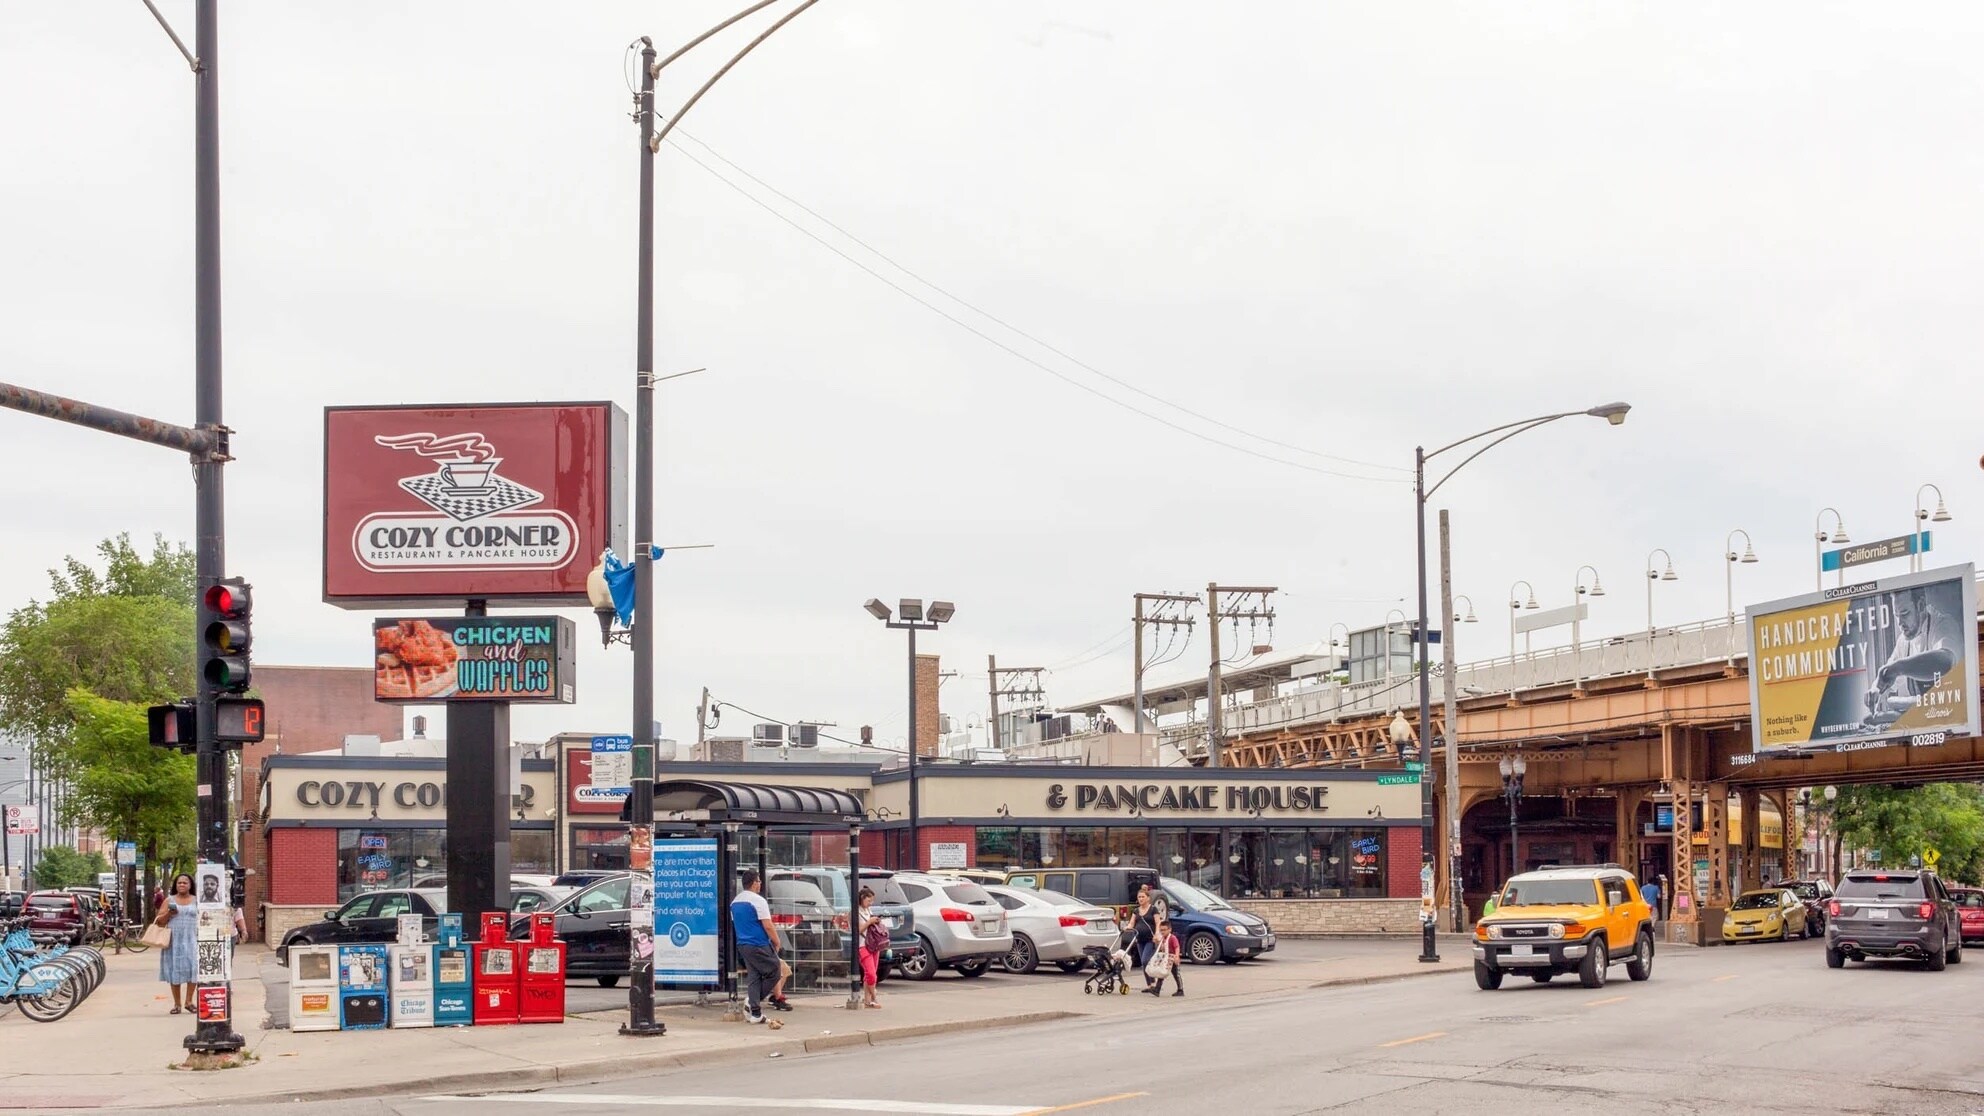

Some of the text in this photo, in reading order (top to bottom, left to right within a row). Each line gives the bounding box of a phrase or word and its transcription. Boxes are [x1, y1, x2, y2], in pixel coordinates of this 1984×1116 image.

[370, 525, 560, 548] COZY CORNER
[371, 551, 441, 559] RESTAURANT
[461, 550, 514, 558] PANCAKE
[521, 549, 559, 557] HOUSE
[1844, 544, 1888, 563] California
[1761, 604, 1890, 649] HANDCRAFTED
[453, 627, 551, 645] CHICKEN
[484, 638, 526, 662] and
[1762, 642, 1869, 681] COMMUNITY
[458, 660, 549, 692] WAFFLES
[1916, 689, 1961, 707] BERWYN
[245, 708, 260, 735] 12
[1766, 714, 1808, 726] Nothing like
[1773, 727, 1800, 737] suburb.
[1912, 732, 1945, 747] 002819
[1731, 754, 1756, 766] 3116684
[1385, 776, 1413, 784] LYNDALE
[296, 781, 536, 809] COZY COR
[1046, 784, 1329, 811] & PANCAKE HOUSE
[364, 838, 385, 847] OPEN
[1352, 837, 1376, 848] EARLY
[1362, 844, 1380, 854] BIRD
[358, 854, 387, 865] EARLY
[699, 857, 716, 866] than
[370, 860, 392, 871] BIRD
[657, 868, 716, 878] places in Chicago
[655, 880, 668, 888] ere
[670, 880, 683, 889] you
[684, 880, 699, 888] can
[654, 890, 716, 900] omputer for free.
[669, 907, 684, 915] one
[685, 906, 706, 917] today.
[400, 999, 426, 1007] Chicago
[400, 1007, 426, 1015] Tribune
